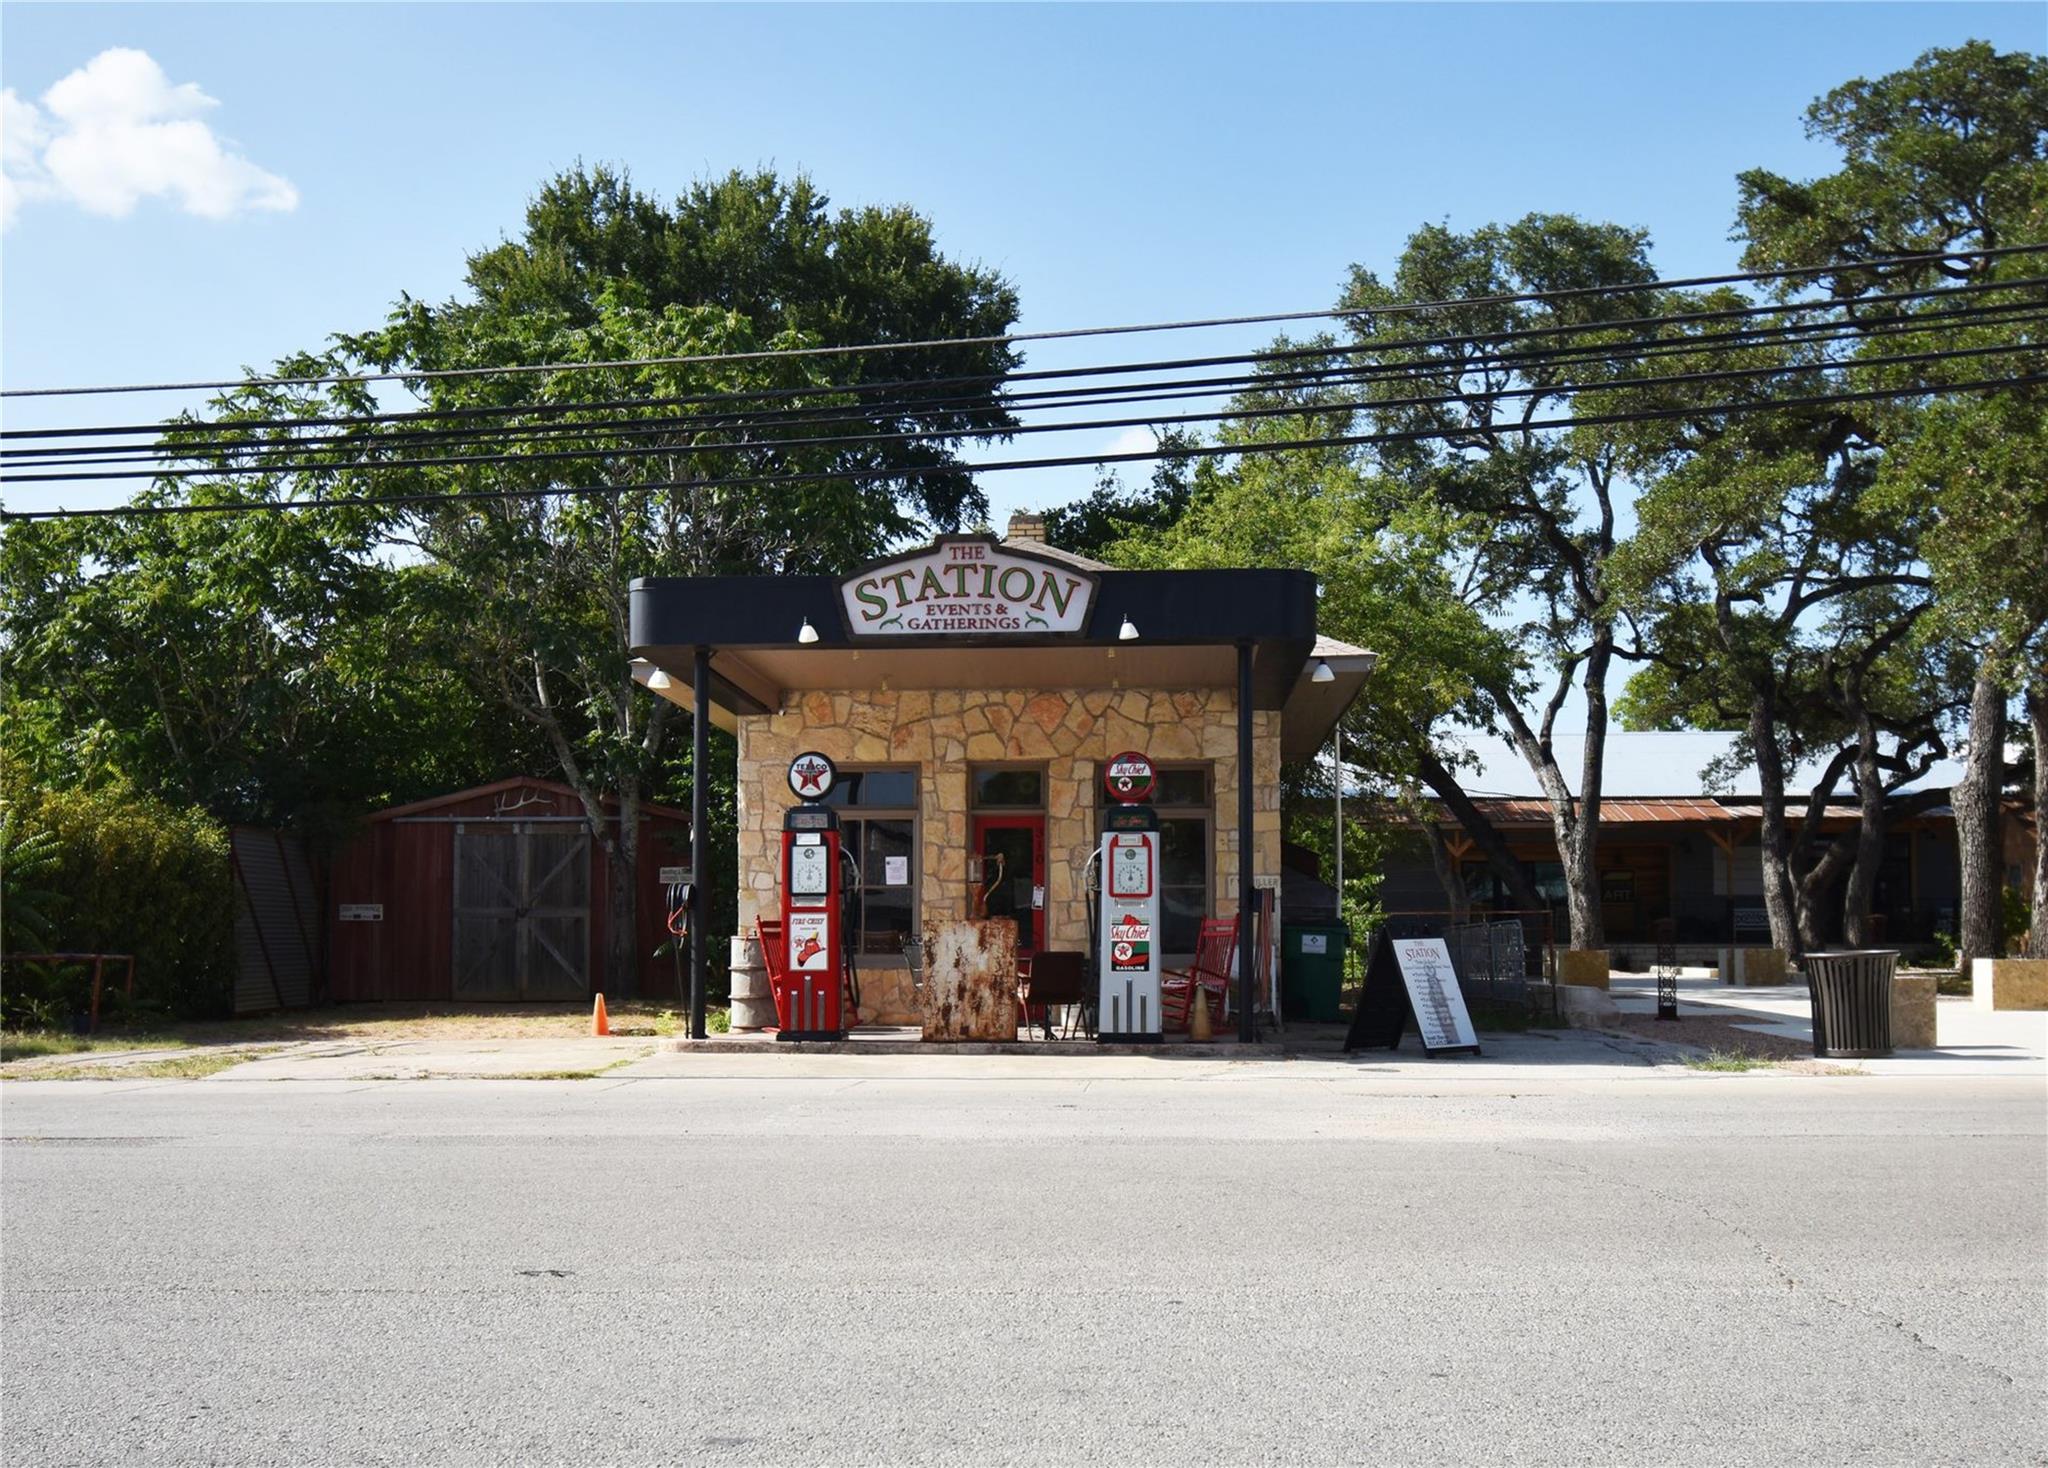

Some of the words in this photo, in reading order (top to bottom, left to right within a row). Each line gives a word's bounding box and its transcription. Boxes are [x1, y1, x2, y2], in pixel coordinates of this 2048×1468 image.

[949, 546, 985, 560] THE
[855, 563, 1081, 622] STATION
[926, 604, 992, 616] EVENTS
[995, 604, 1008, 615] &
[907, 618, 1020, 631] GATHERINGS
[1603, 889, 1632, 901] ART
[1126, 925, 1149, 939] Chief
[1405, 948, 1440, 961] STATION
